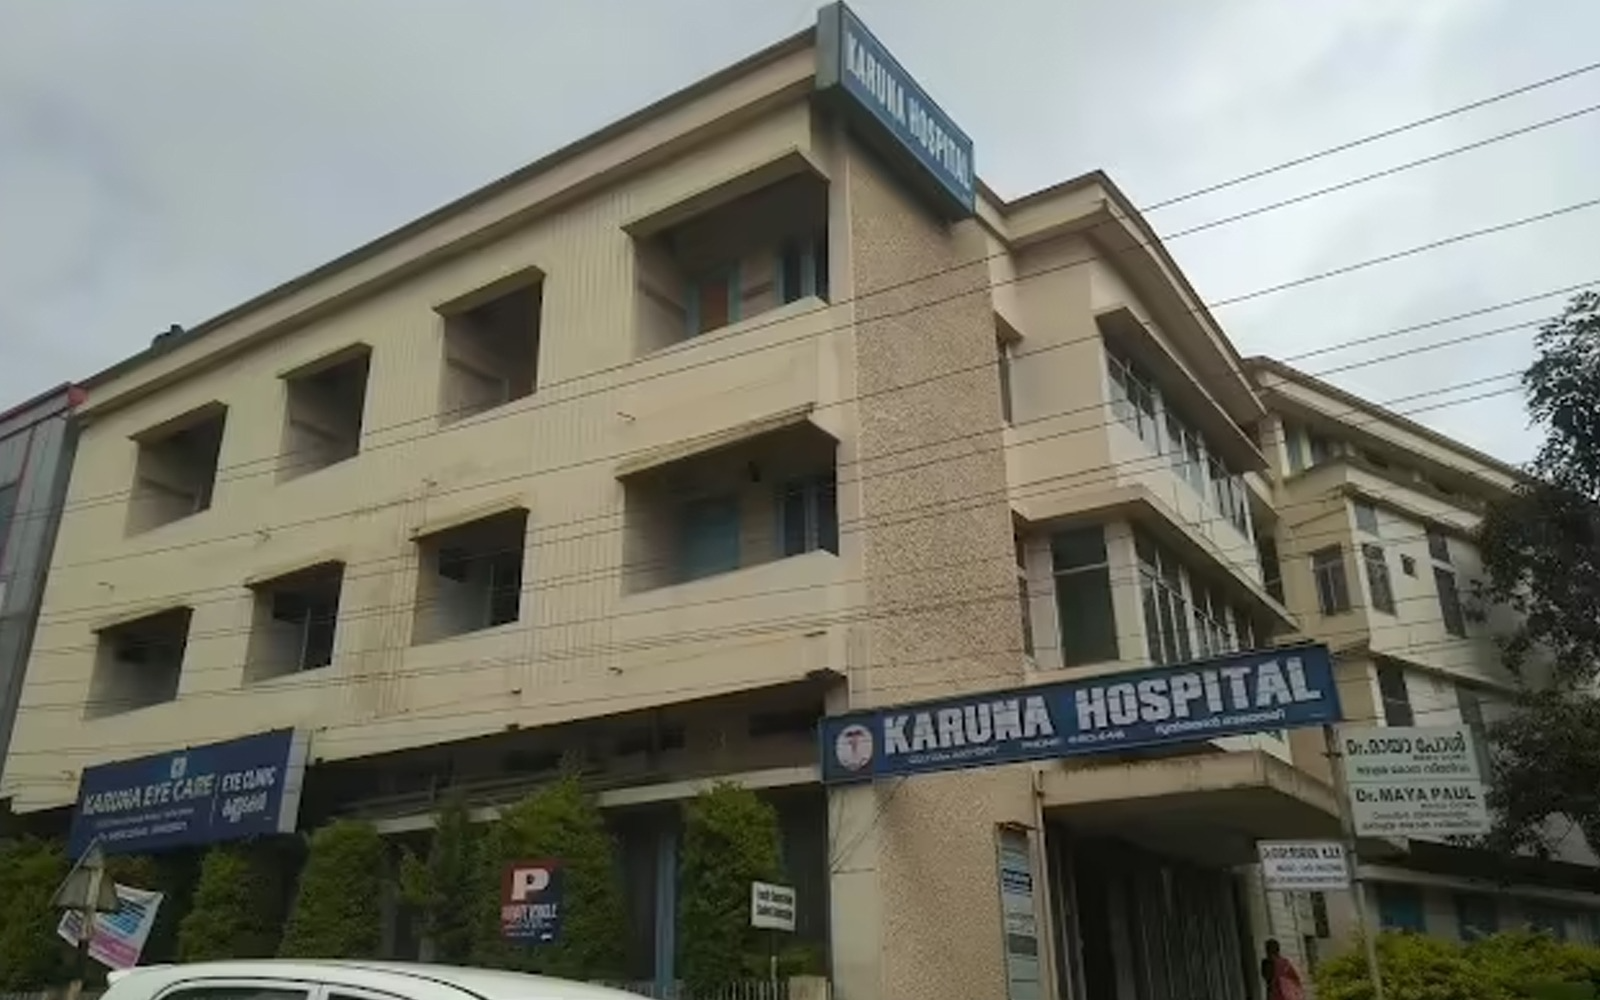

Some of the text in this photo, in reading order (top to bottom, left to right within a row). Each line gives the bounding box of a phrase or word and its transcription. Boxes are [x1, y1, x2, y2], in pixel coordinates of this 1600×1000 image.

[846, 32, 971, 191] KARUNA HOSPITAL
[884, 695, 1053, 754] KARUNA
[1074, 657, 1322, 727] HOSPITAL
[1430, 786, 1476, 801] PAUL
[511, 867, 550, 901] P
